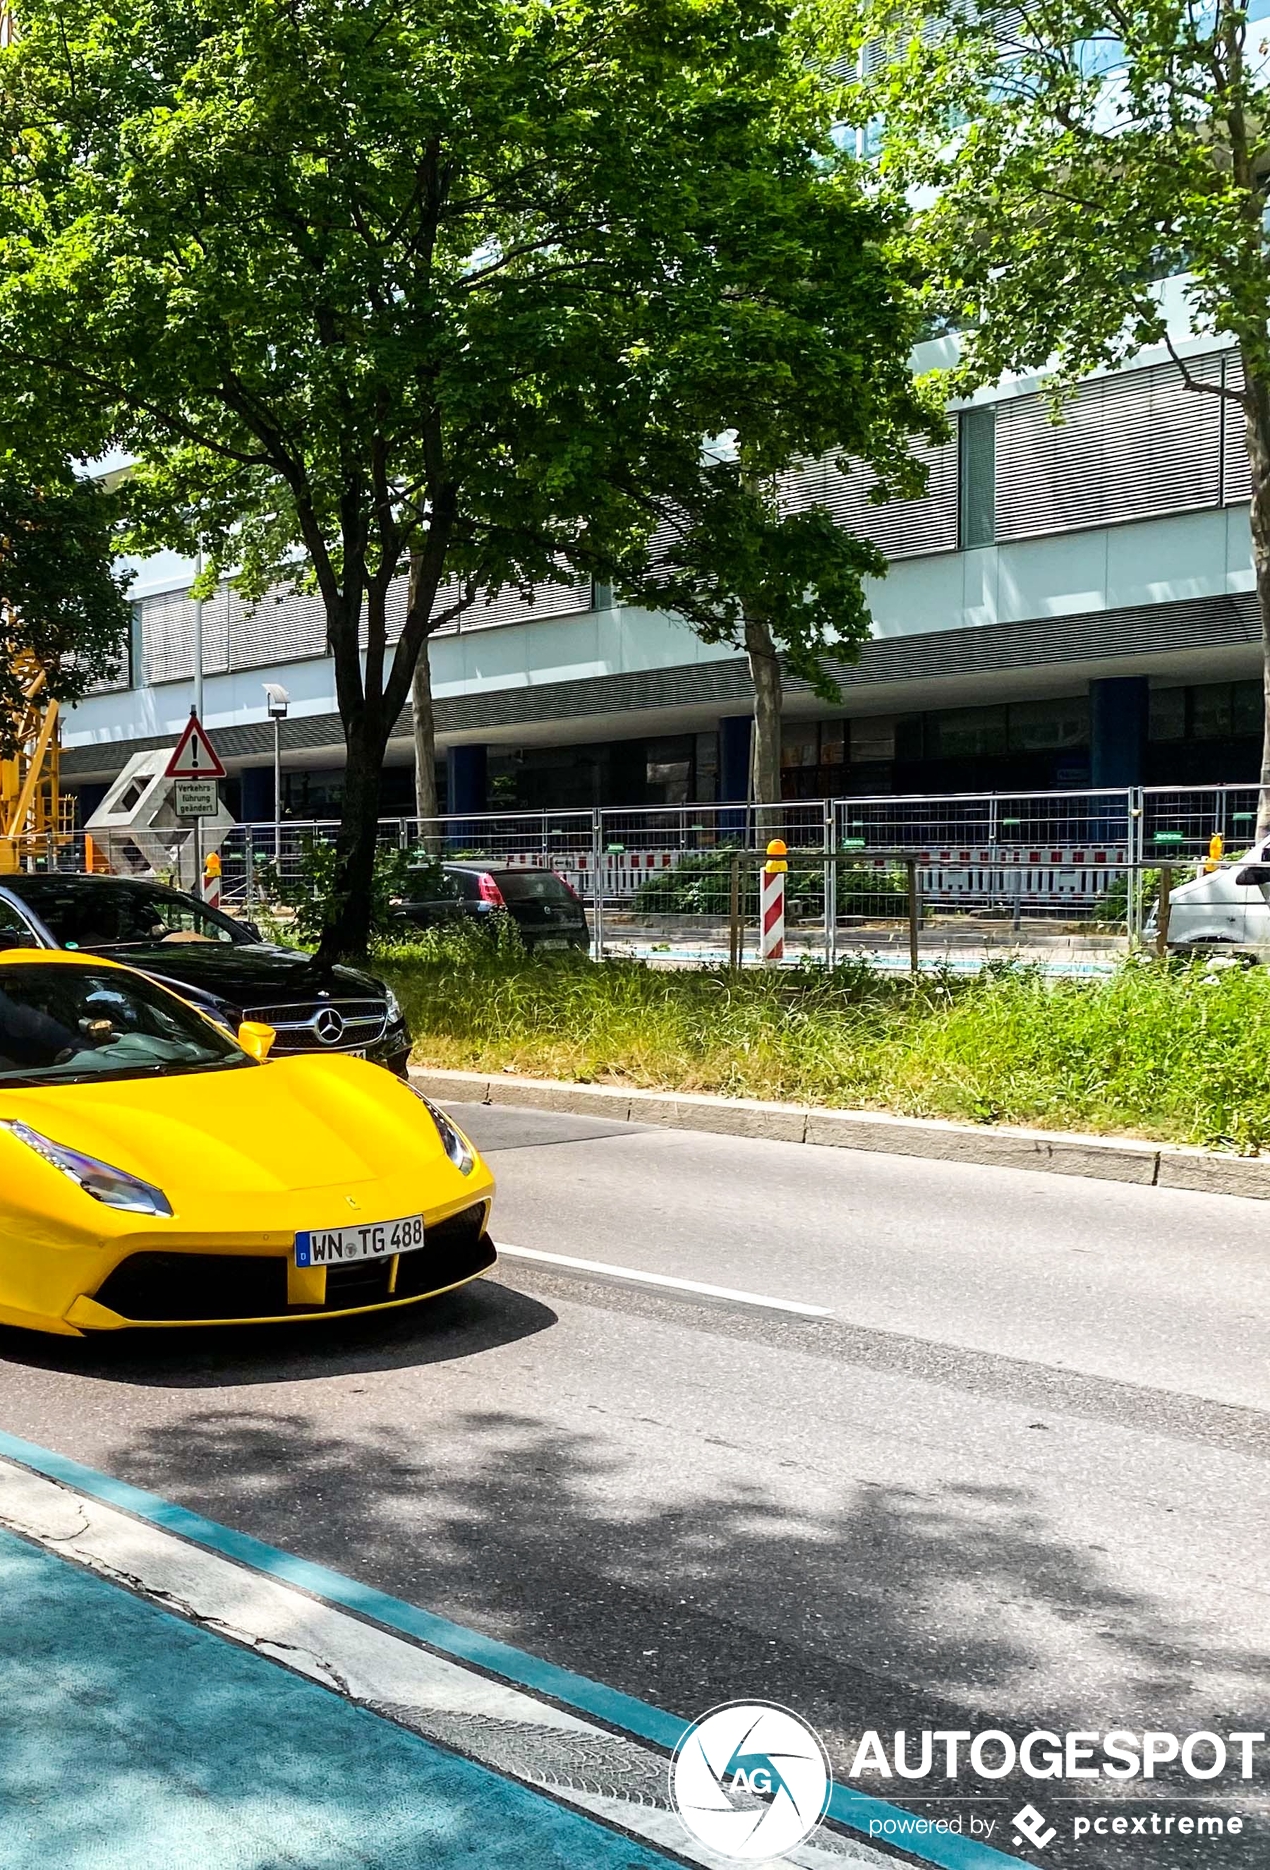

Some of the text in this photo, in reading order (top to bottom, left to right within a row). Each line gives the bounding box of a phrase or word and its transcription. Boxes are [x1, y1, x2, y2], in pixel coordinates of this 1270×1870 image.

[178, 784, 215, 793] Verkehrs-
[182, 794, 211, 804] führung
[180, 804, 213, 814] geändert
[312, 1232, 343, 1261] WN
[358, 1227, 385, 1255] TG
[390, 1219, 422, 1249] 488
